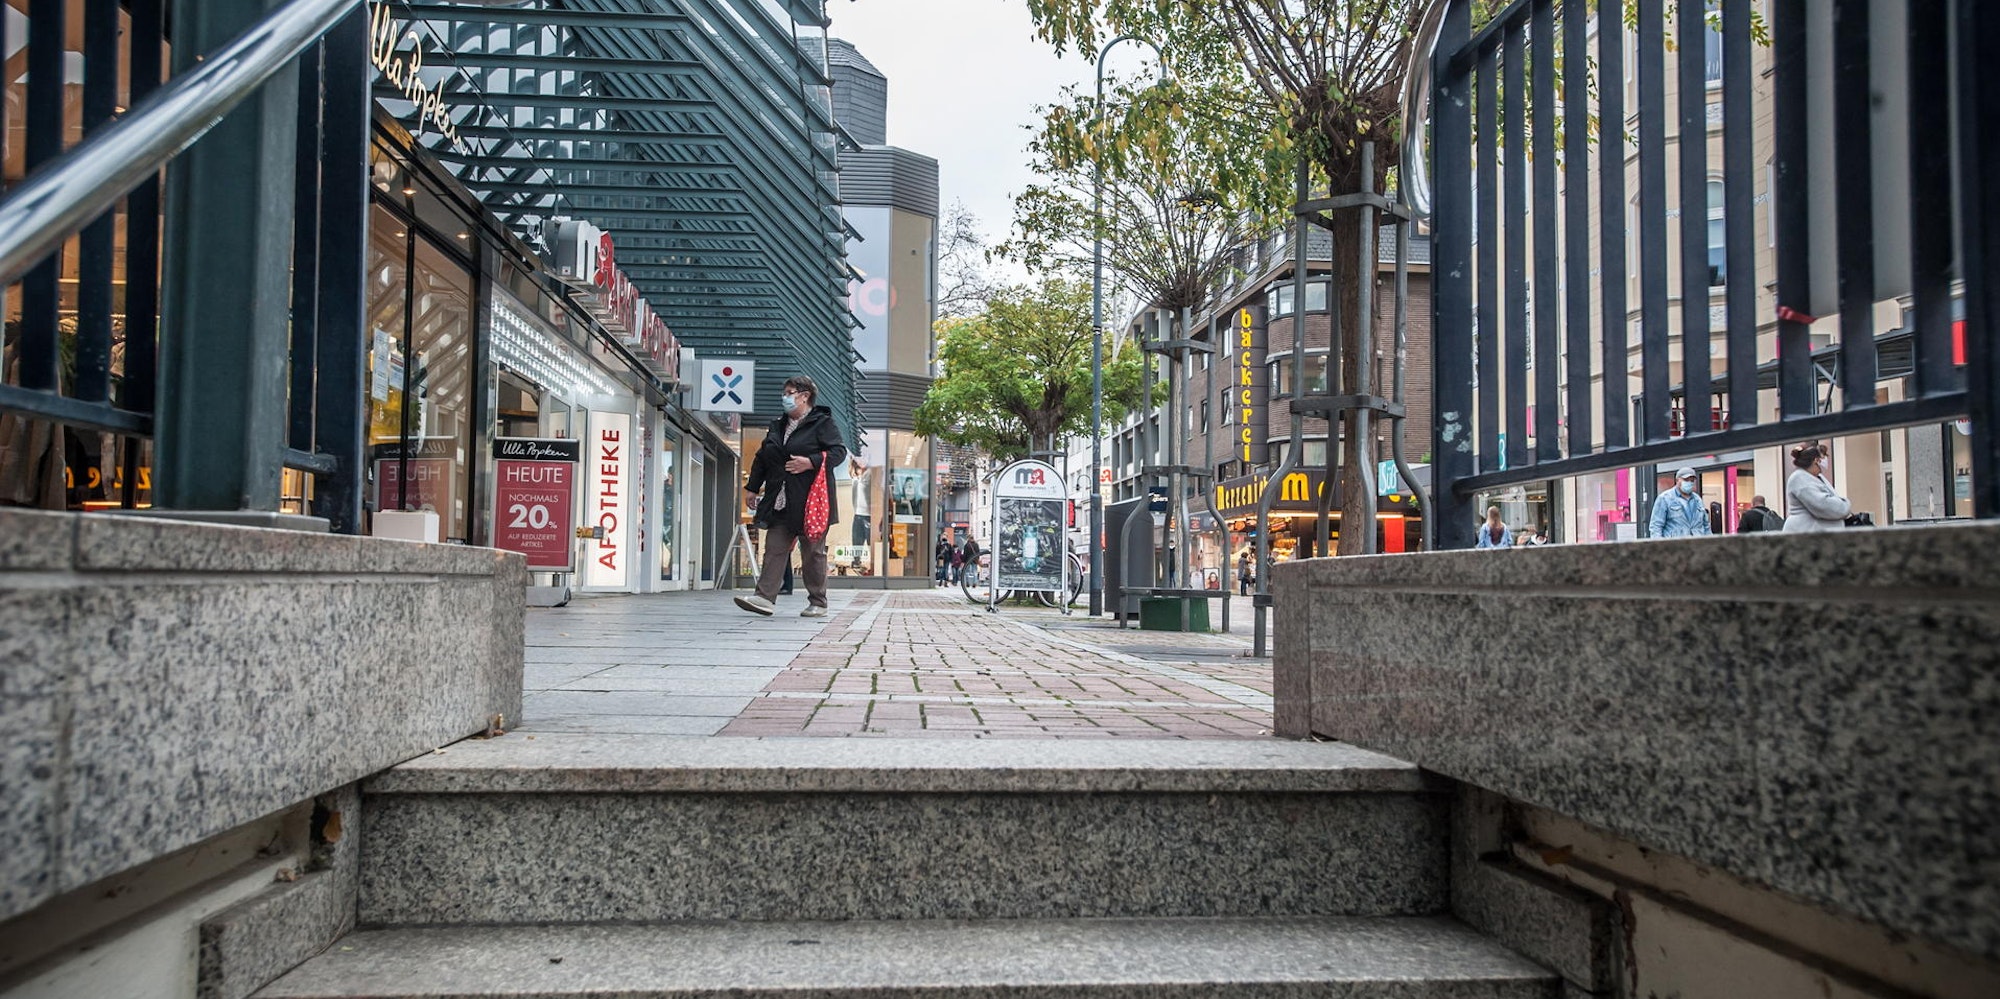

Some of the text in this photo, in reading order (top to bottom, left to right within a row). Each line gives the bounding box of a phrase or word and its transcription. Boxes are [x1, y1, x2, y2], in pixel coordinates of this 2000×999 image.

[406, 31, 468, 156] Popken
[502, 441, 570, 459] Ulla Popken
[506, 466, 563, 483] HEUTE
[508, 494, 559, 503] NOCHMALS
[599, 429, 620, 571] APOTHEKE
[508, 503, 558, 529] 20%
[520, 540, 543, 548] ARTIKEL
[521, 533, 557, 541] REDUZIERTE
